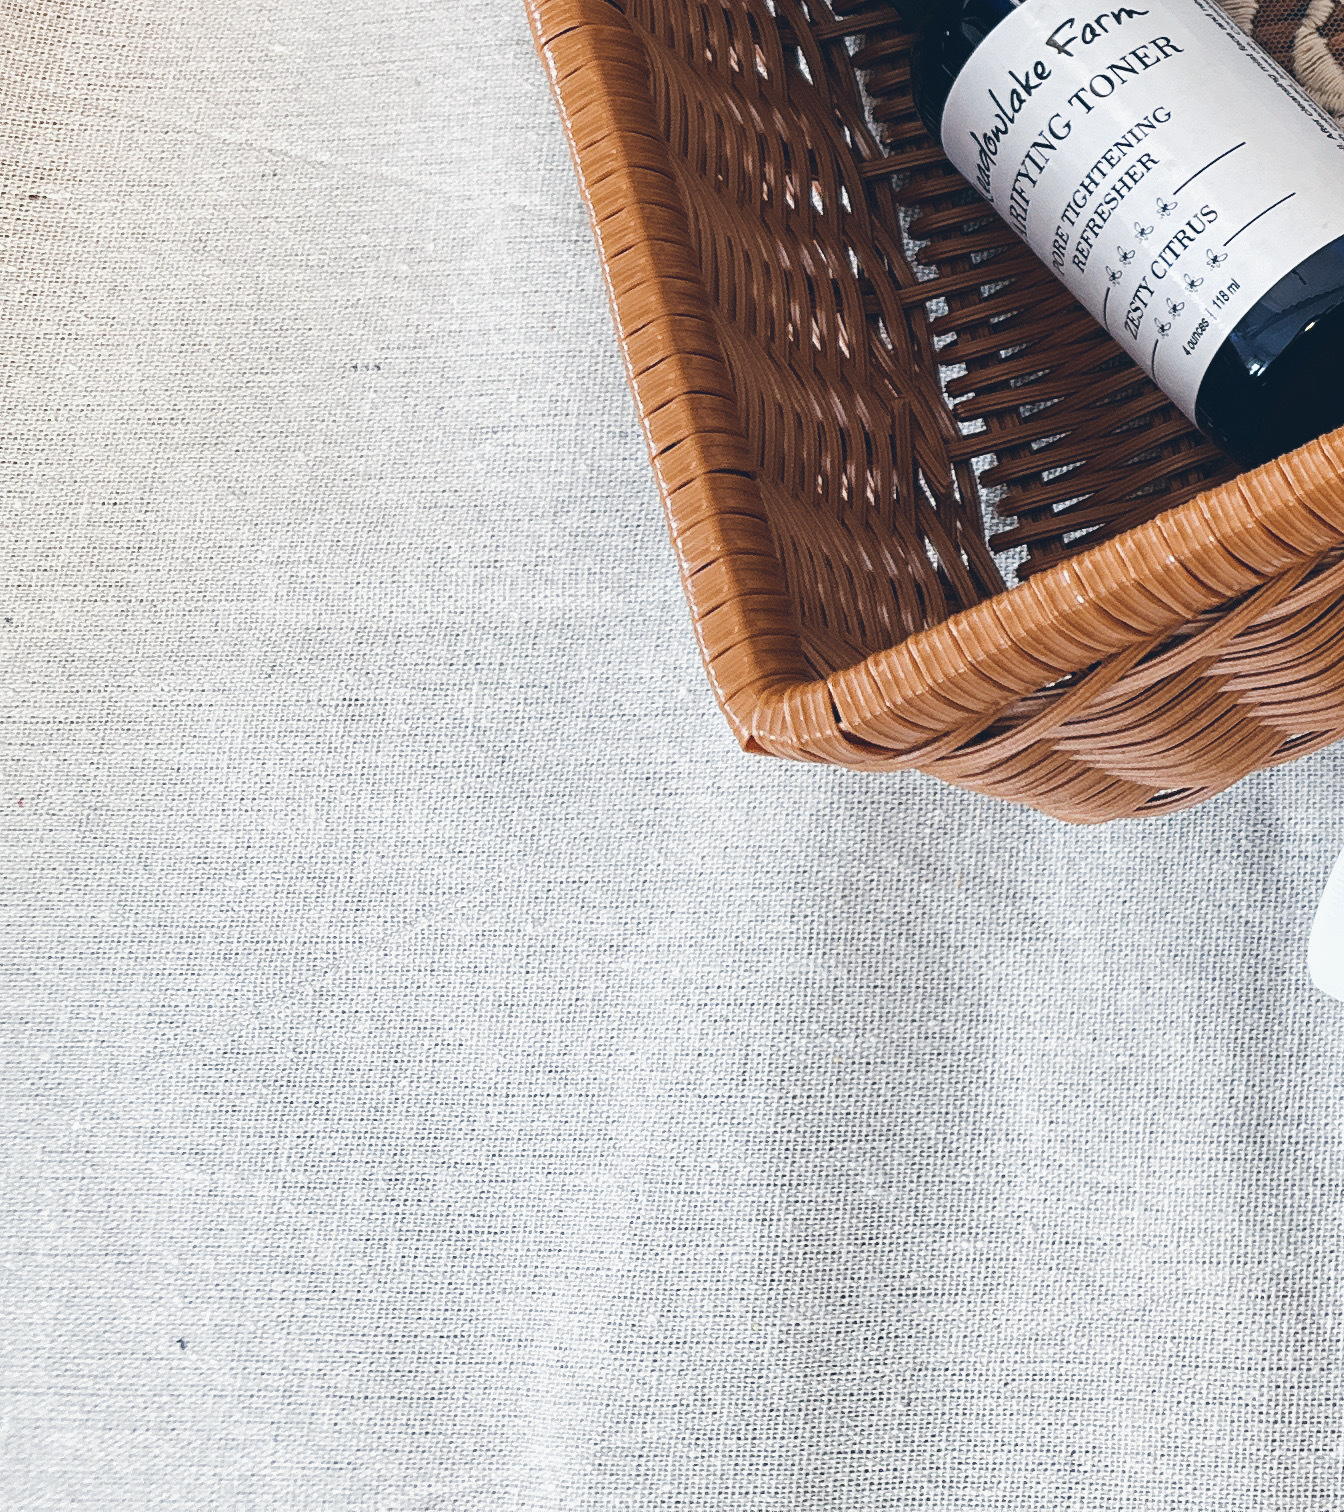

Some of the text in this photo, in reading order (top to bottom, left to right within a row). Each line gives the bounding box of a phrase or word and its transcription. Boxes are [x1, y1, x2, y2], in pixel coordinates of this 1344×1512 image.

[968, 6, 1150, 205] eadowlake Farm
[1066, 35, 1185, 115] TONER
[1051, 105, 1172, 279] PORE TIGHTENING
[1070, 152, 1160, 275] REFRESHER
[1123, 204, 1219, 342] ZESTY CITRUS
[1181, 277, 1241, 356] 4 ounces 118 ml
